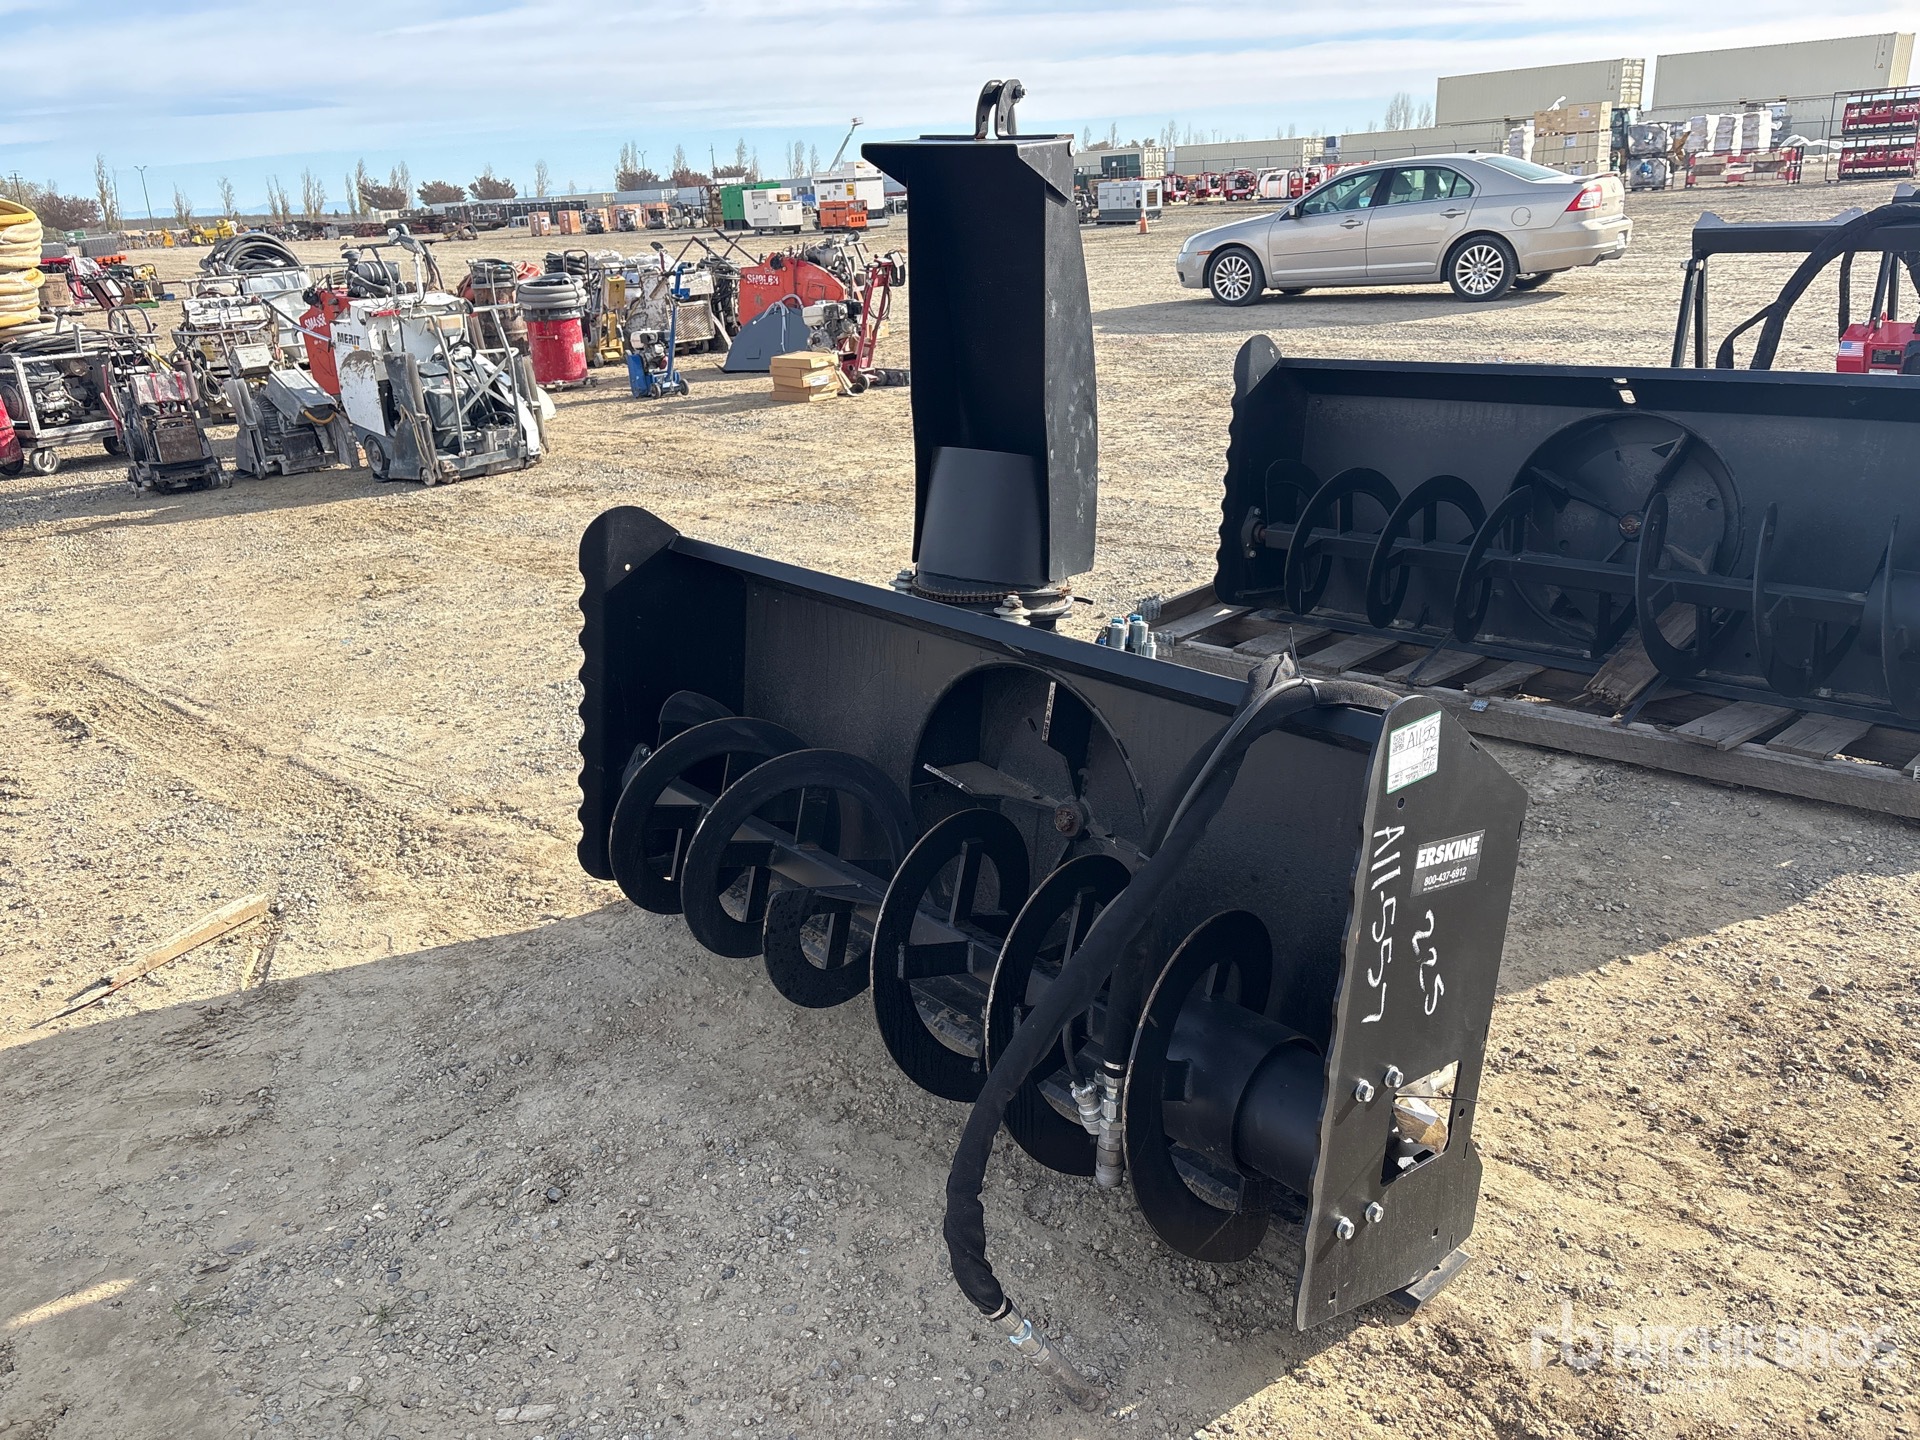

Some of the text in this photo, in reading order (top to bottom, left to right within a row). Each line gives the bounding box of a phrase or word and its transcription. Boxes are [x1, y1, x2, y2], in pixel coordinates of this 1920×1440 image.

[336, 331, 360, 346] MERIT
[1415, 835, 1481, 870] ERSKINE
[1423, 866, 1468, 887] 800-437-6912
[1411, 909, 1445, 1016] 225
